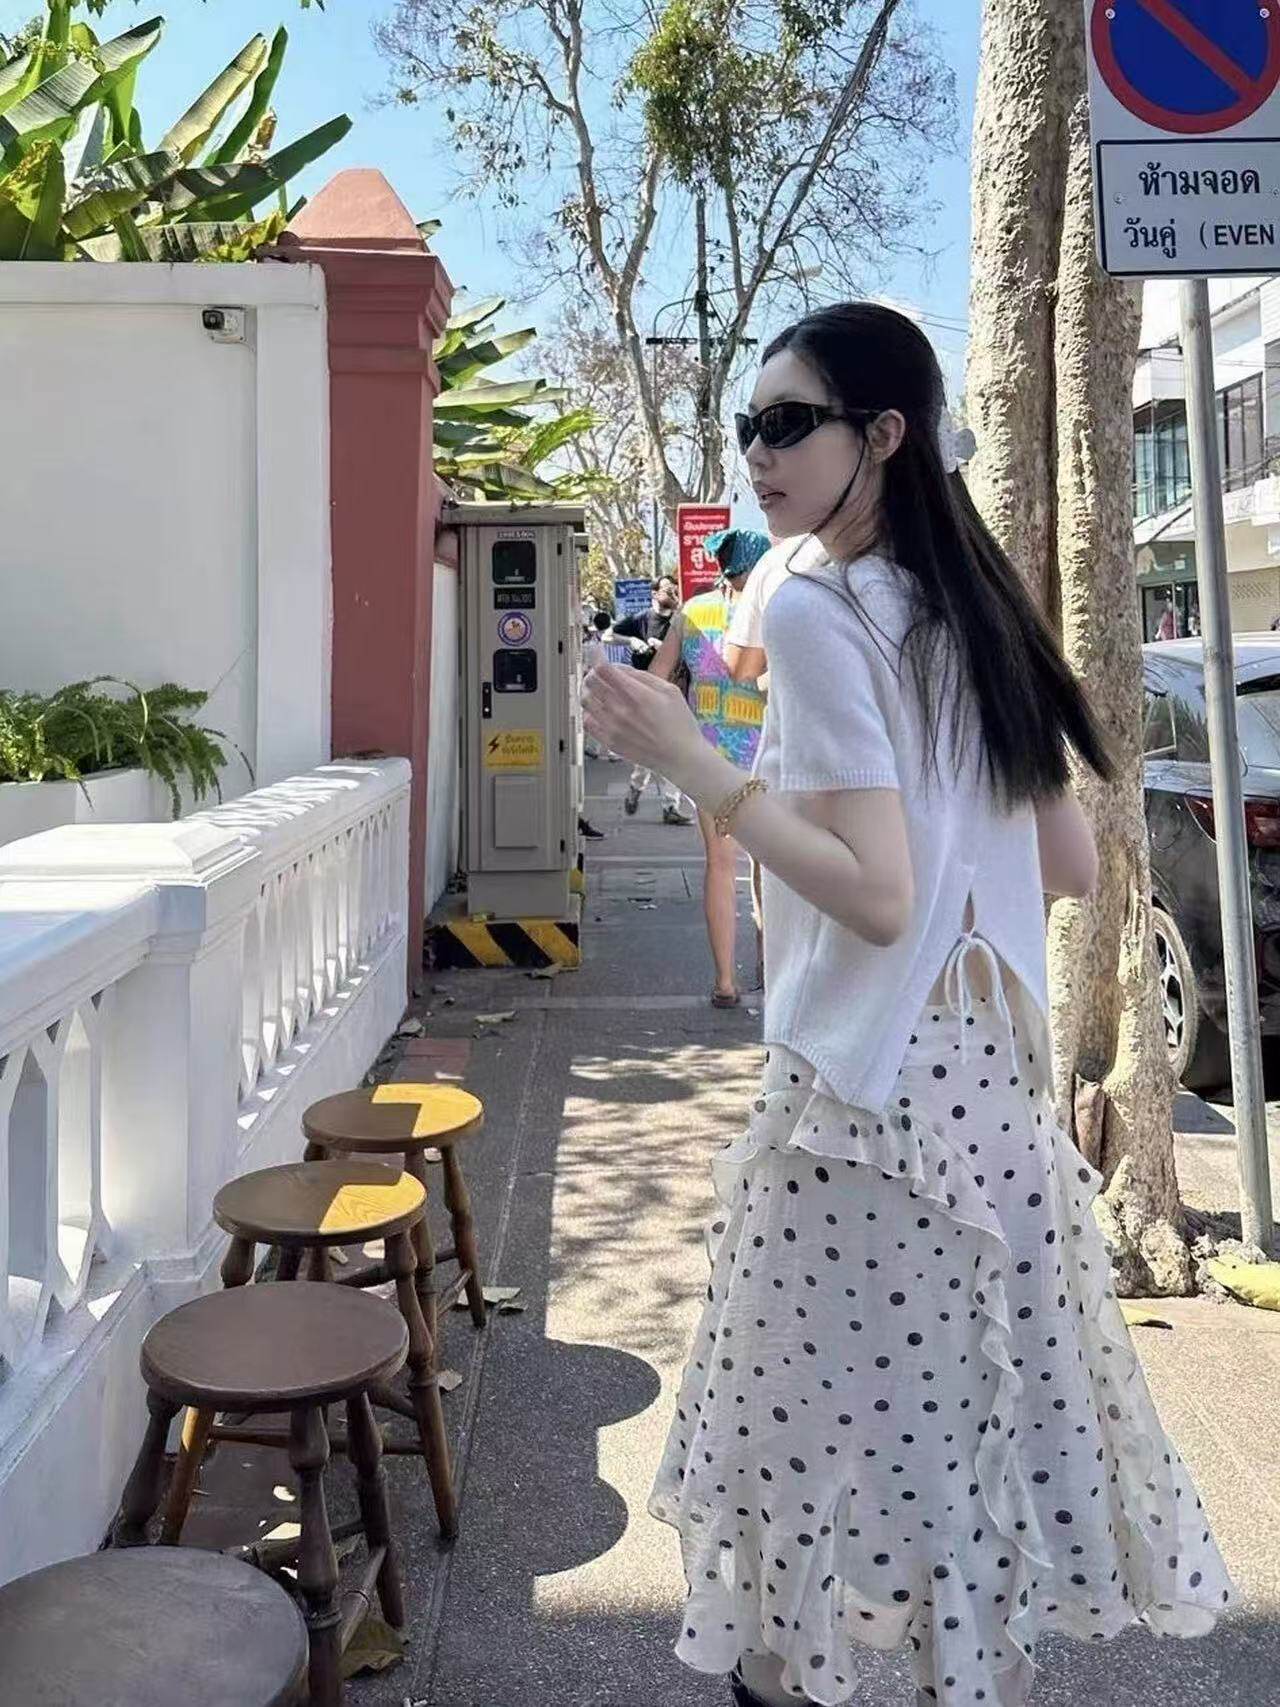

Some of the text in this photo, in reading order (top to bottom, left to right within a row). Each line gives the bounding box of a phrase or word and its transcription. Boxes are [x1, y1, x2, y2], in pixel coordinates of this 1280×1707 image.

[1138, 162, 1260, 196] ห้ามจอด
[1124, 217, 1177, 259] วันคู่
